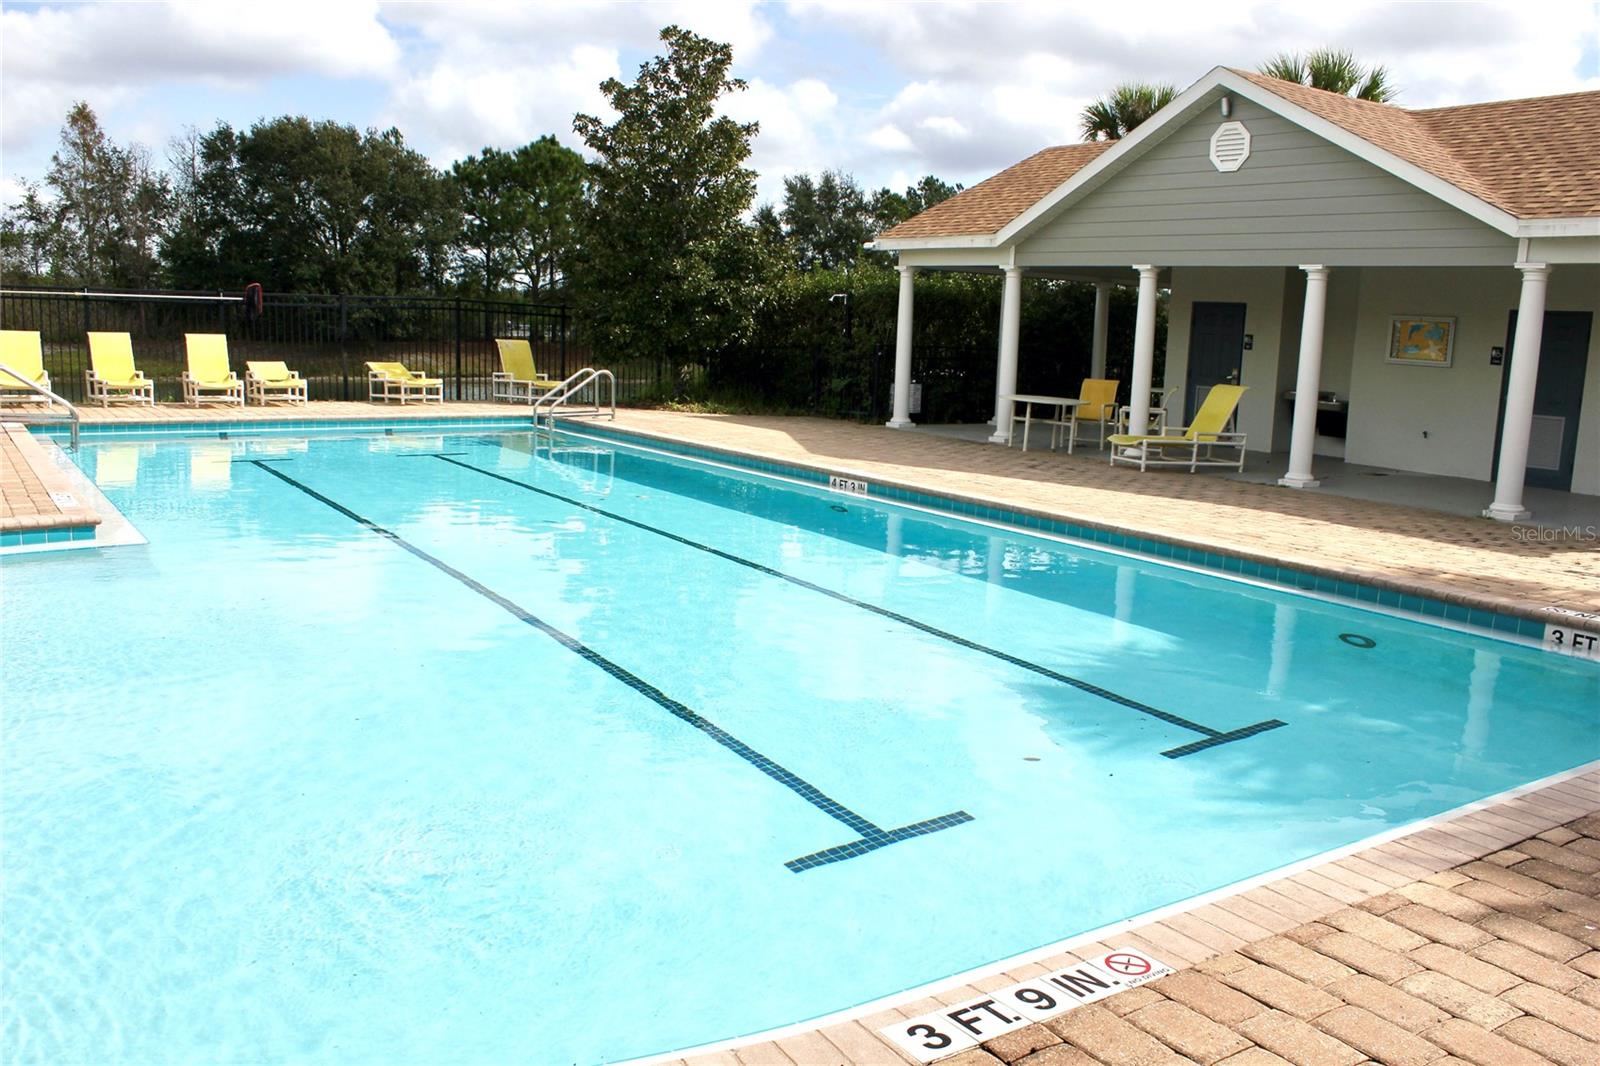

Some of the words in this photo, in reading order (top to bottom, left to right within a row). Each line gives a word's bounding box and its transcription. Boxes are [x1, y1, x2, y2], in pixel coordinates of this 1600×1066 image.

[839, 479, 848, 490] FT
[850, 482, 856, 491] 3
[857, 483, 866, 492] IN
[1551, 629, 1564, 645] 3
[1572, 633, 1598, 651] FT
[906, 1023, 951, 1049] 3
[947, 999, 1022, 1035] FT.
[1014, 988, 1057, 1010] 9
[1050, 969, 1121, 997] IN.
